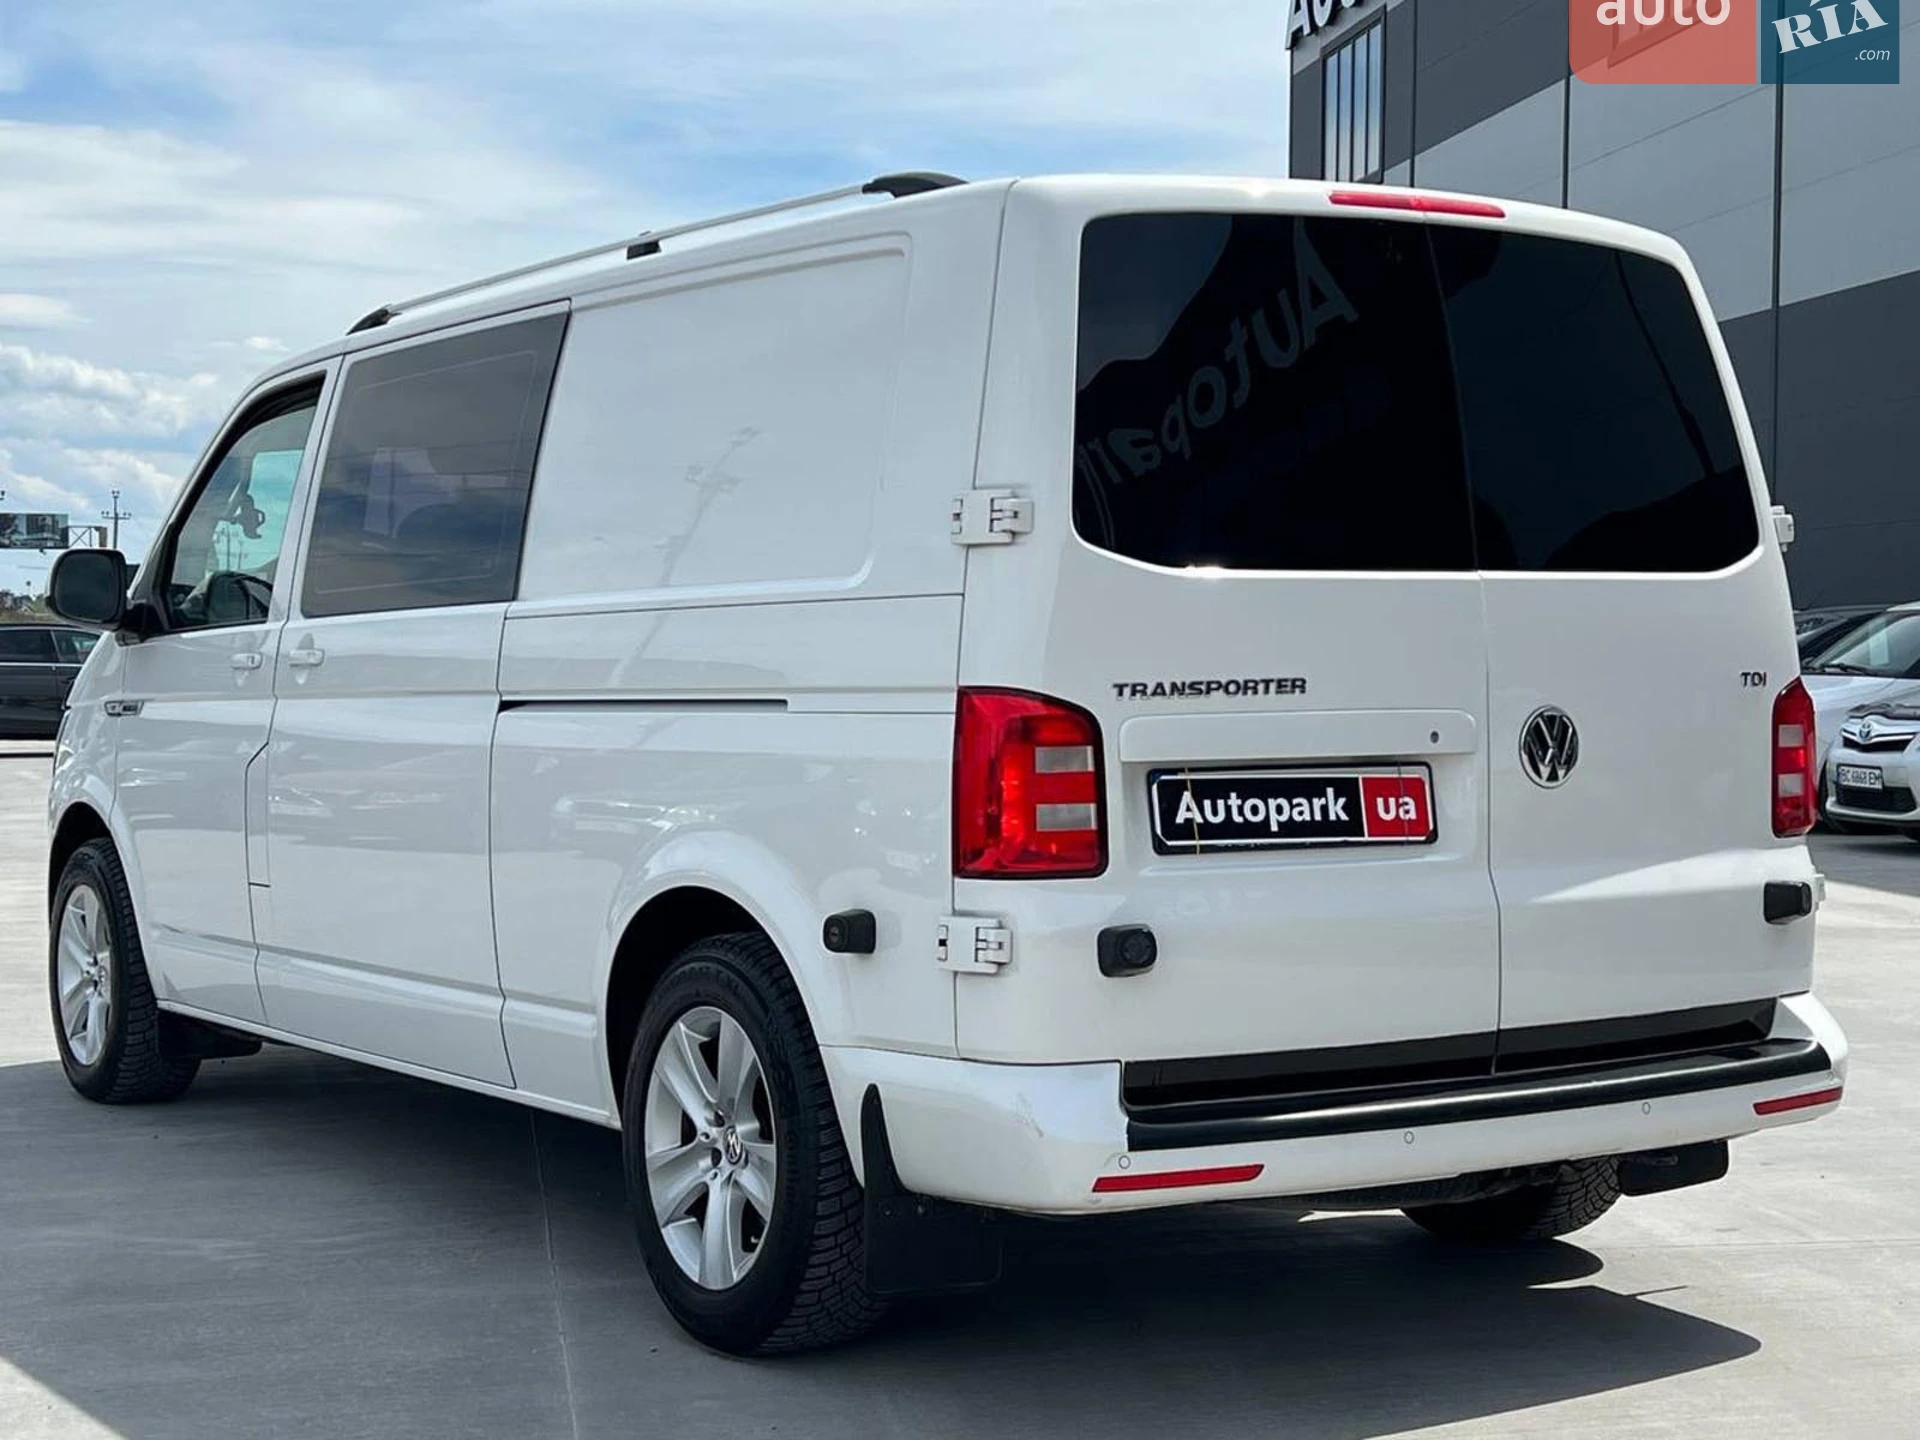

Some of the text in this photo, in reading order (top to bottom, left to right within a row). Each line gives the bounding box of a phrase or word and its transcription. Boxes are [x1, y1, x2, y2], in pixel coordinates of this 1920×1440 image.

[1113, 677, 1307, 700] TRANSPORTER
[1740, 671, 1767, 687] TDI
[1175, 787, 1417, 832] Autopark ua
